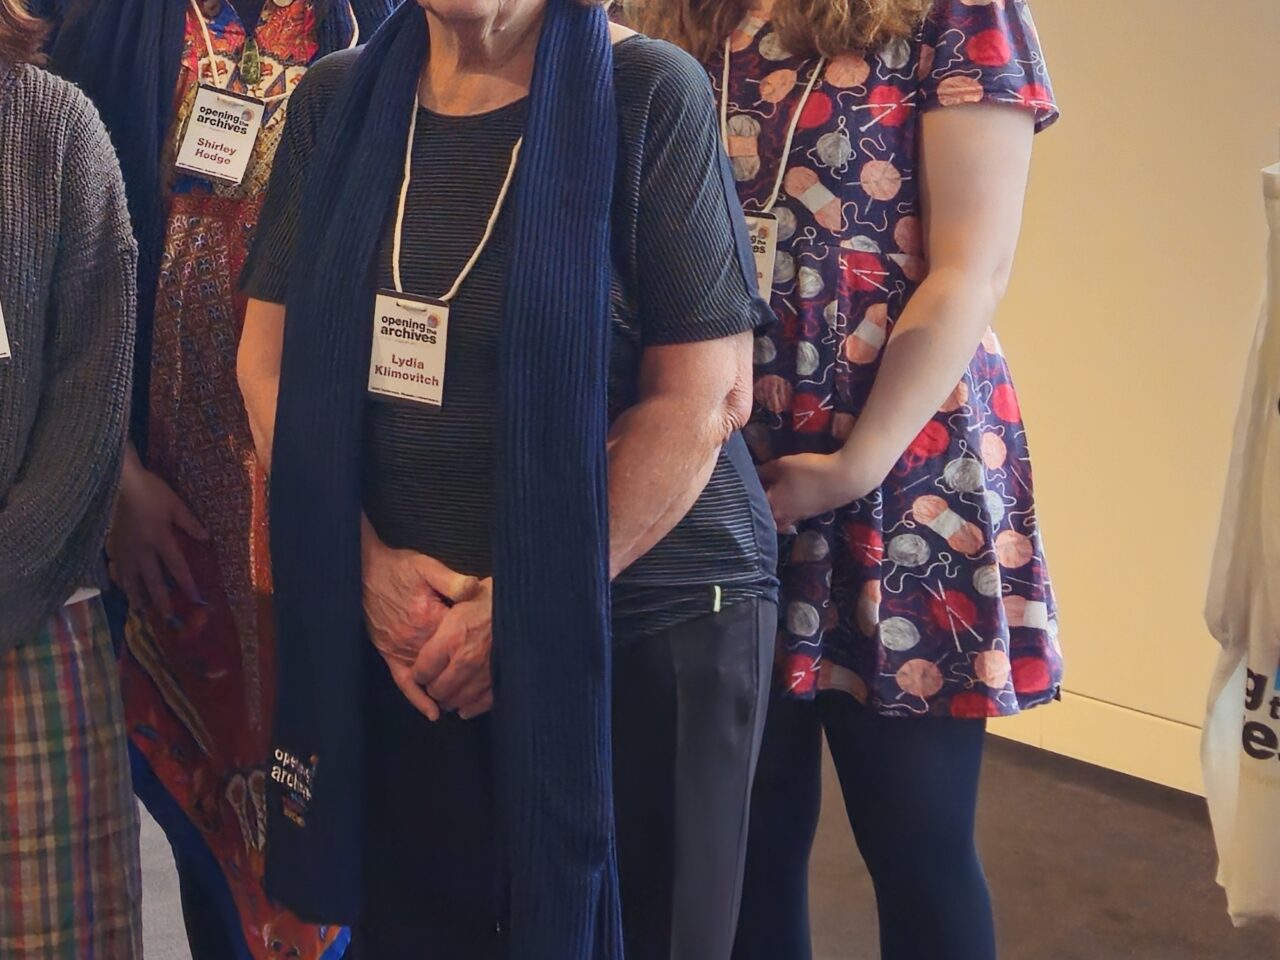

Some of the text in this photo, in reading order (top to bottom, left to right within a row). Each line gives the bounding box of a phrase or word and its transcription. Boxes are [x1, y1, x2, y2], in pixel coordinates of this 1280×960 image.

[197, 114, 247, 135] archives
[199, 106, 240, 124] opening
[197, 137, 237, 156] Shirley
[381, 315, 426, 333] opening
[380, 325, 437, 345] archives
[391, 353, 425, 370] Lydia
[375, 364, 439, 387] Klimovitch
